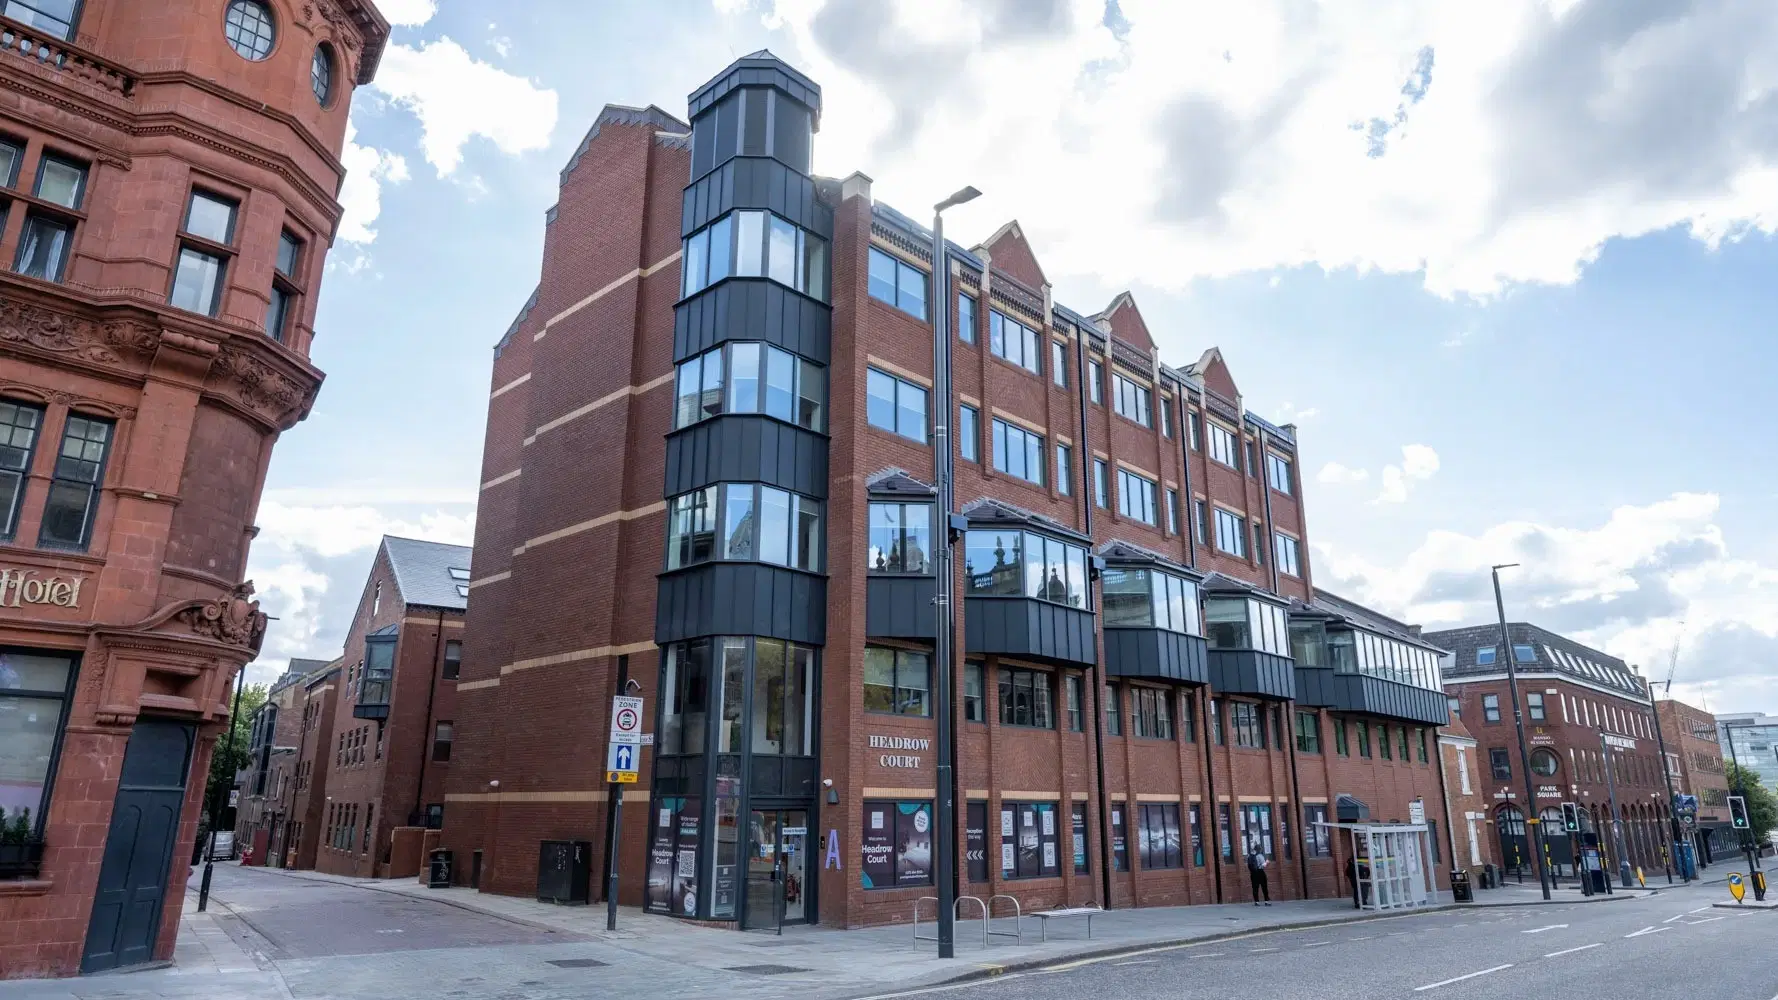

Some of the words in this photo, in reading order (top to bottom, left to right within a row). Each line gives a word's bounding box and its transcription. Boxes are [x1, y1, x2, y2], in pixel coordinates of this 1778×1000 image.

[0, 568, 88, 608] Hotel
[869, 735, 931, 751] HEADROW
[880, 754, 921, 769] COURT
[652, 848, 674, 857] Headrow
[825, 829, 841, 870] A
[861, 844, 893, 854] Headrow
[655, 857, 669, 865] Court
[867, 854, 888, 864] Court
